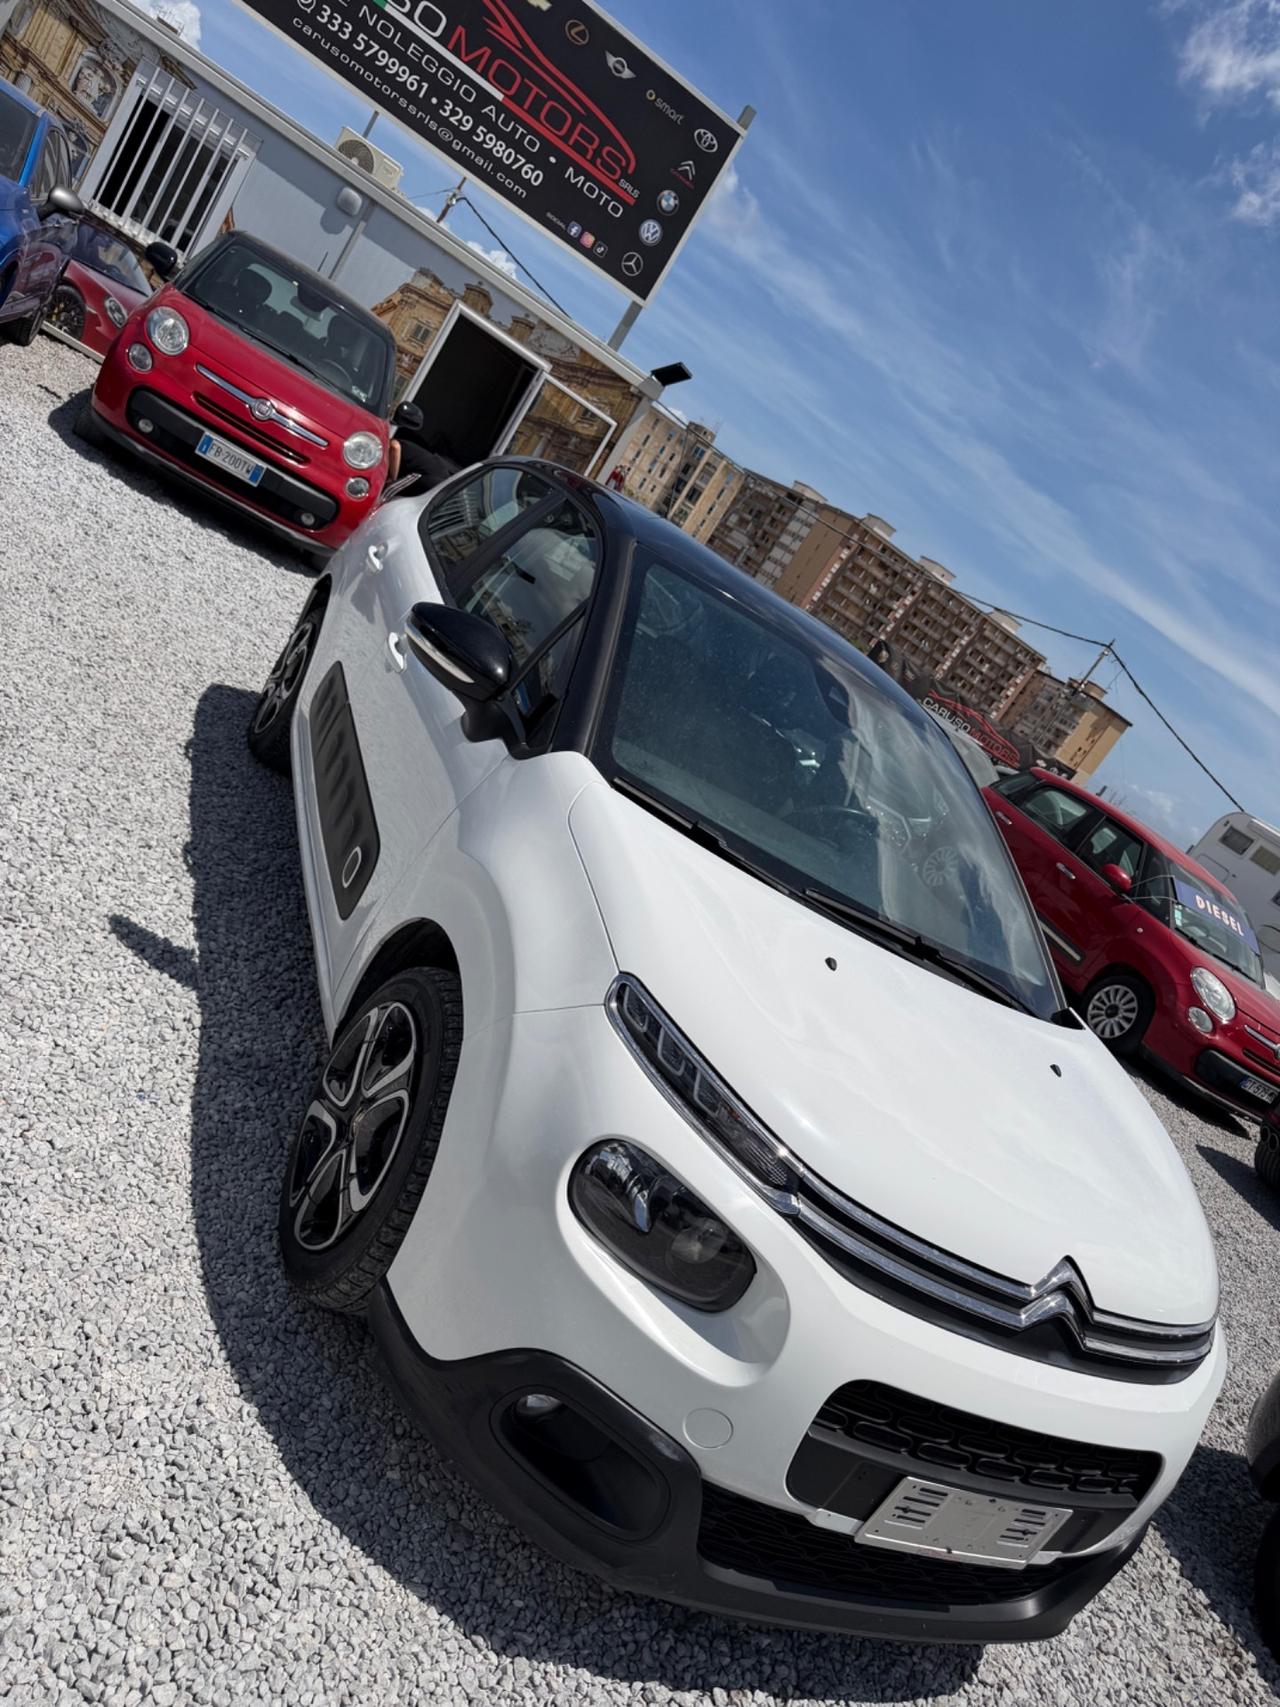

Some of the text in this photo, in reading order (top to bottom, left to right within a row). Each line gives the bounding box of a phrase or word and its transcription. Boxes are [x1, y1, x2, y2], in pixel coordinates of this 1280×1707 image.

[293, 18, 527, 198] carusomotorssrls@gmail.com
[316, 5, 544, 187] 333 5799961 329 5980760
[358, 5, 477, 103] NOLEGGIO
[481, 104, 541, 153] AUTO
[564, 166, 624, 218] MOTO
[447, 24, 627, 181] MOTORS
[618, 178, 641, 199] SRLS
[654, 98, 685, 125] smart
[922, 697, 1018, 763] CARUSO MOTORS
[1195, 894, 1244, 937] DIESEL
